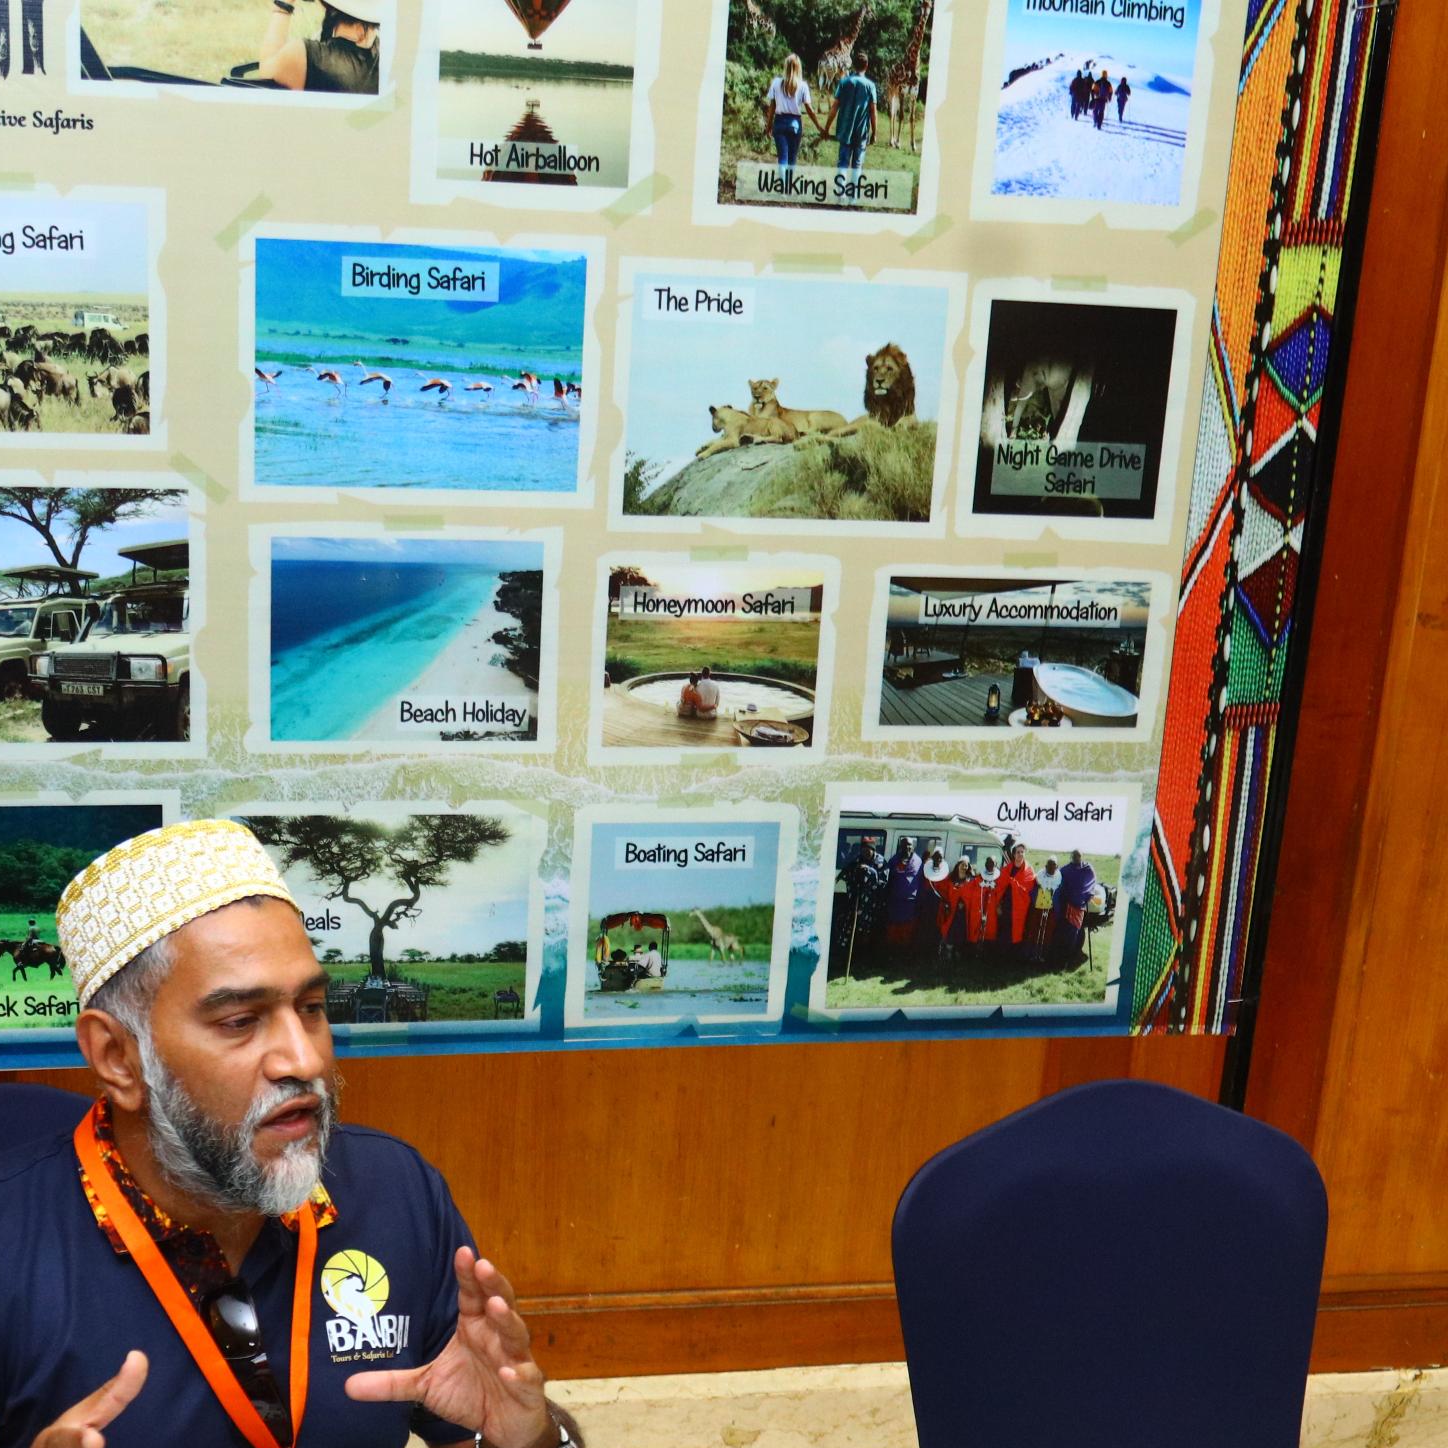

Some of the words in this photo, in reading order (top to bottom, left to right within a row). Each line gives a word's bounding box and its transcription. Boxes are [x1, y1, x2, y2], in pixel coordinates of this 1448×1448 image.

[1111, 0, 1185, 29] Climbing
[32, 110, 94, 134] Safaris
[470, 142, 501, 167] Hot
[506, 143, 599, 172] Airballoon
[757, 169, 827, 202] Walking
[833, 174, 888, 200] Safari
[22, 225, 84, 251] Safari
[352, 262, 421, 295] Birding
[427, 266, 485, 292] Safari
[654, 288, 689, 313] The
[695, 289, 744, 315] Pride
[996, 442, 1042, 471] Night
[1046, 444, 1094, 468] Game
[1099, 446, 1142, 471] Drive
[1044, 472, 1095, 494] Safari
[633, 591, 736, 617] Honeymoon
[741, 593, 795, 615] Safari
[924, 595, 982, 622] Luxury
[986, 596, 1118, 622] Accommodation
[400, 700, 456, 723] Beach
[463, 700, 527, 727] Holiday
[996, 801, 1059, 822] Cultural
[1064, 802, 1113, 822] Safari
[624, 842, 688, 868] Boating
[694, 842, 745, 864] Safari
[24, 995, 80, 1016] Safari
[331, 1352, 352, 1363] Tours
[362, 1350, 385, 1361] Safaris
